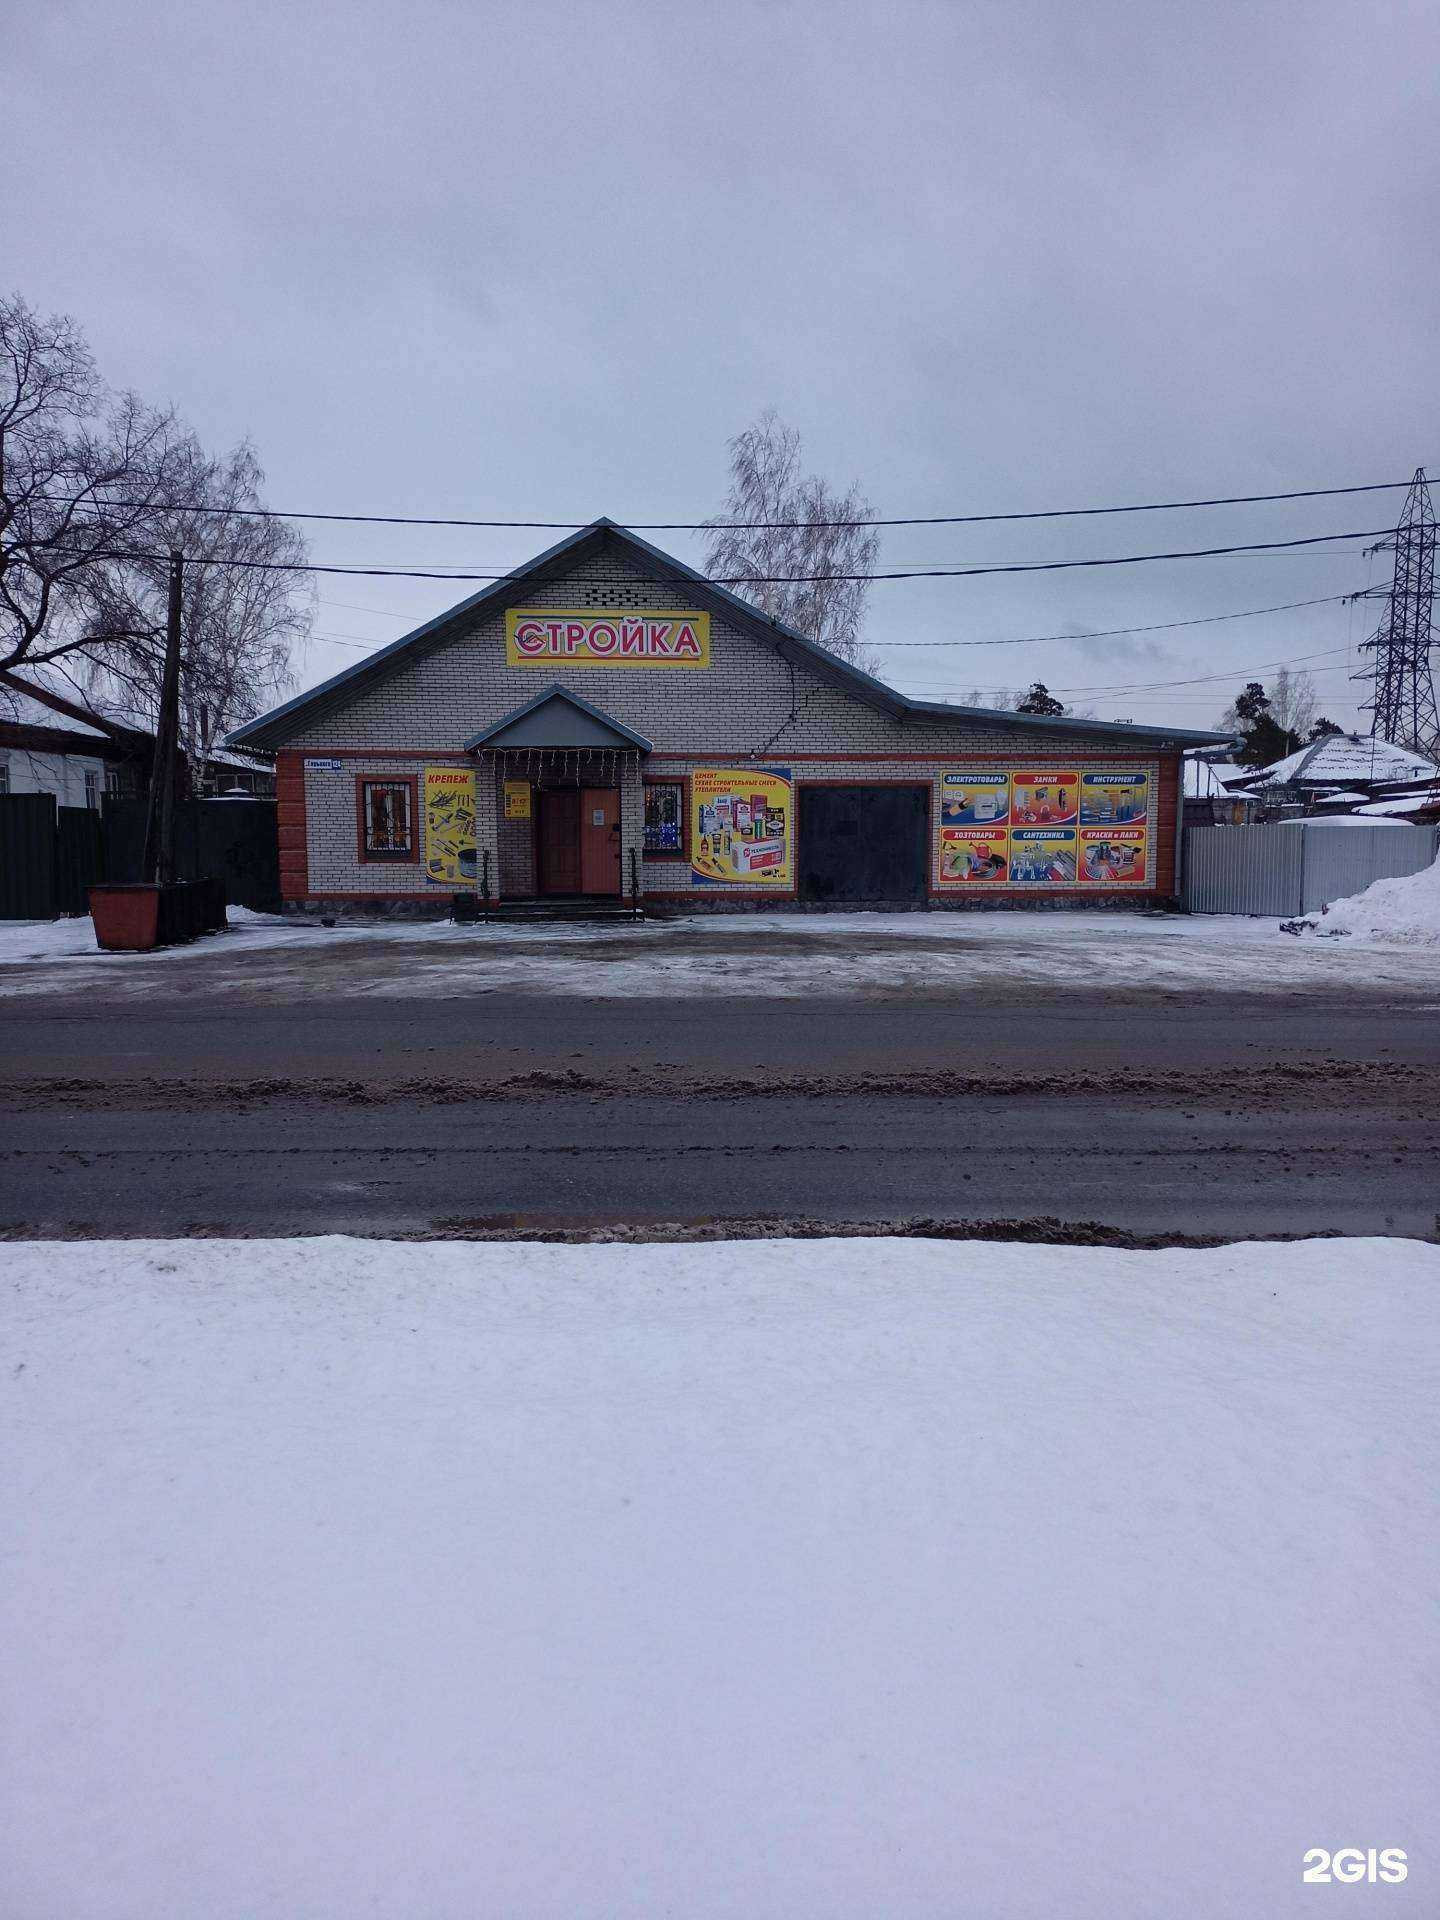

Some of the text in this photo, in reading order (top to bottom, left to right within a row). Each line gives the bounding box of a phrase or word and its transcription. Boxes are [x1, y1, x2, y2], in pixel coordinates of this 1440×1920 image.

[515, 617, 701, 655] СТРОЙКА
[428, 774, 469, 784] КРЕПЕЖ
[947, 775, 1005, 784] ЭЛЕКТРОТОВАРЫ
[1033, 775, 1058, 783] ЗАМКИ
[1092, 775, 1136, 784] ИНСТРУМЕНТ
[953, 831, 996, 839] ХОЗТОВАРЫ
[1022, 831, 1065, 839] САНТЕХНИКА
[1086, 831, 1113, 839] КРАСКИ
[1119, 831, 1139, 839] ЛАКИ
